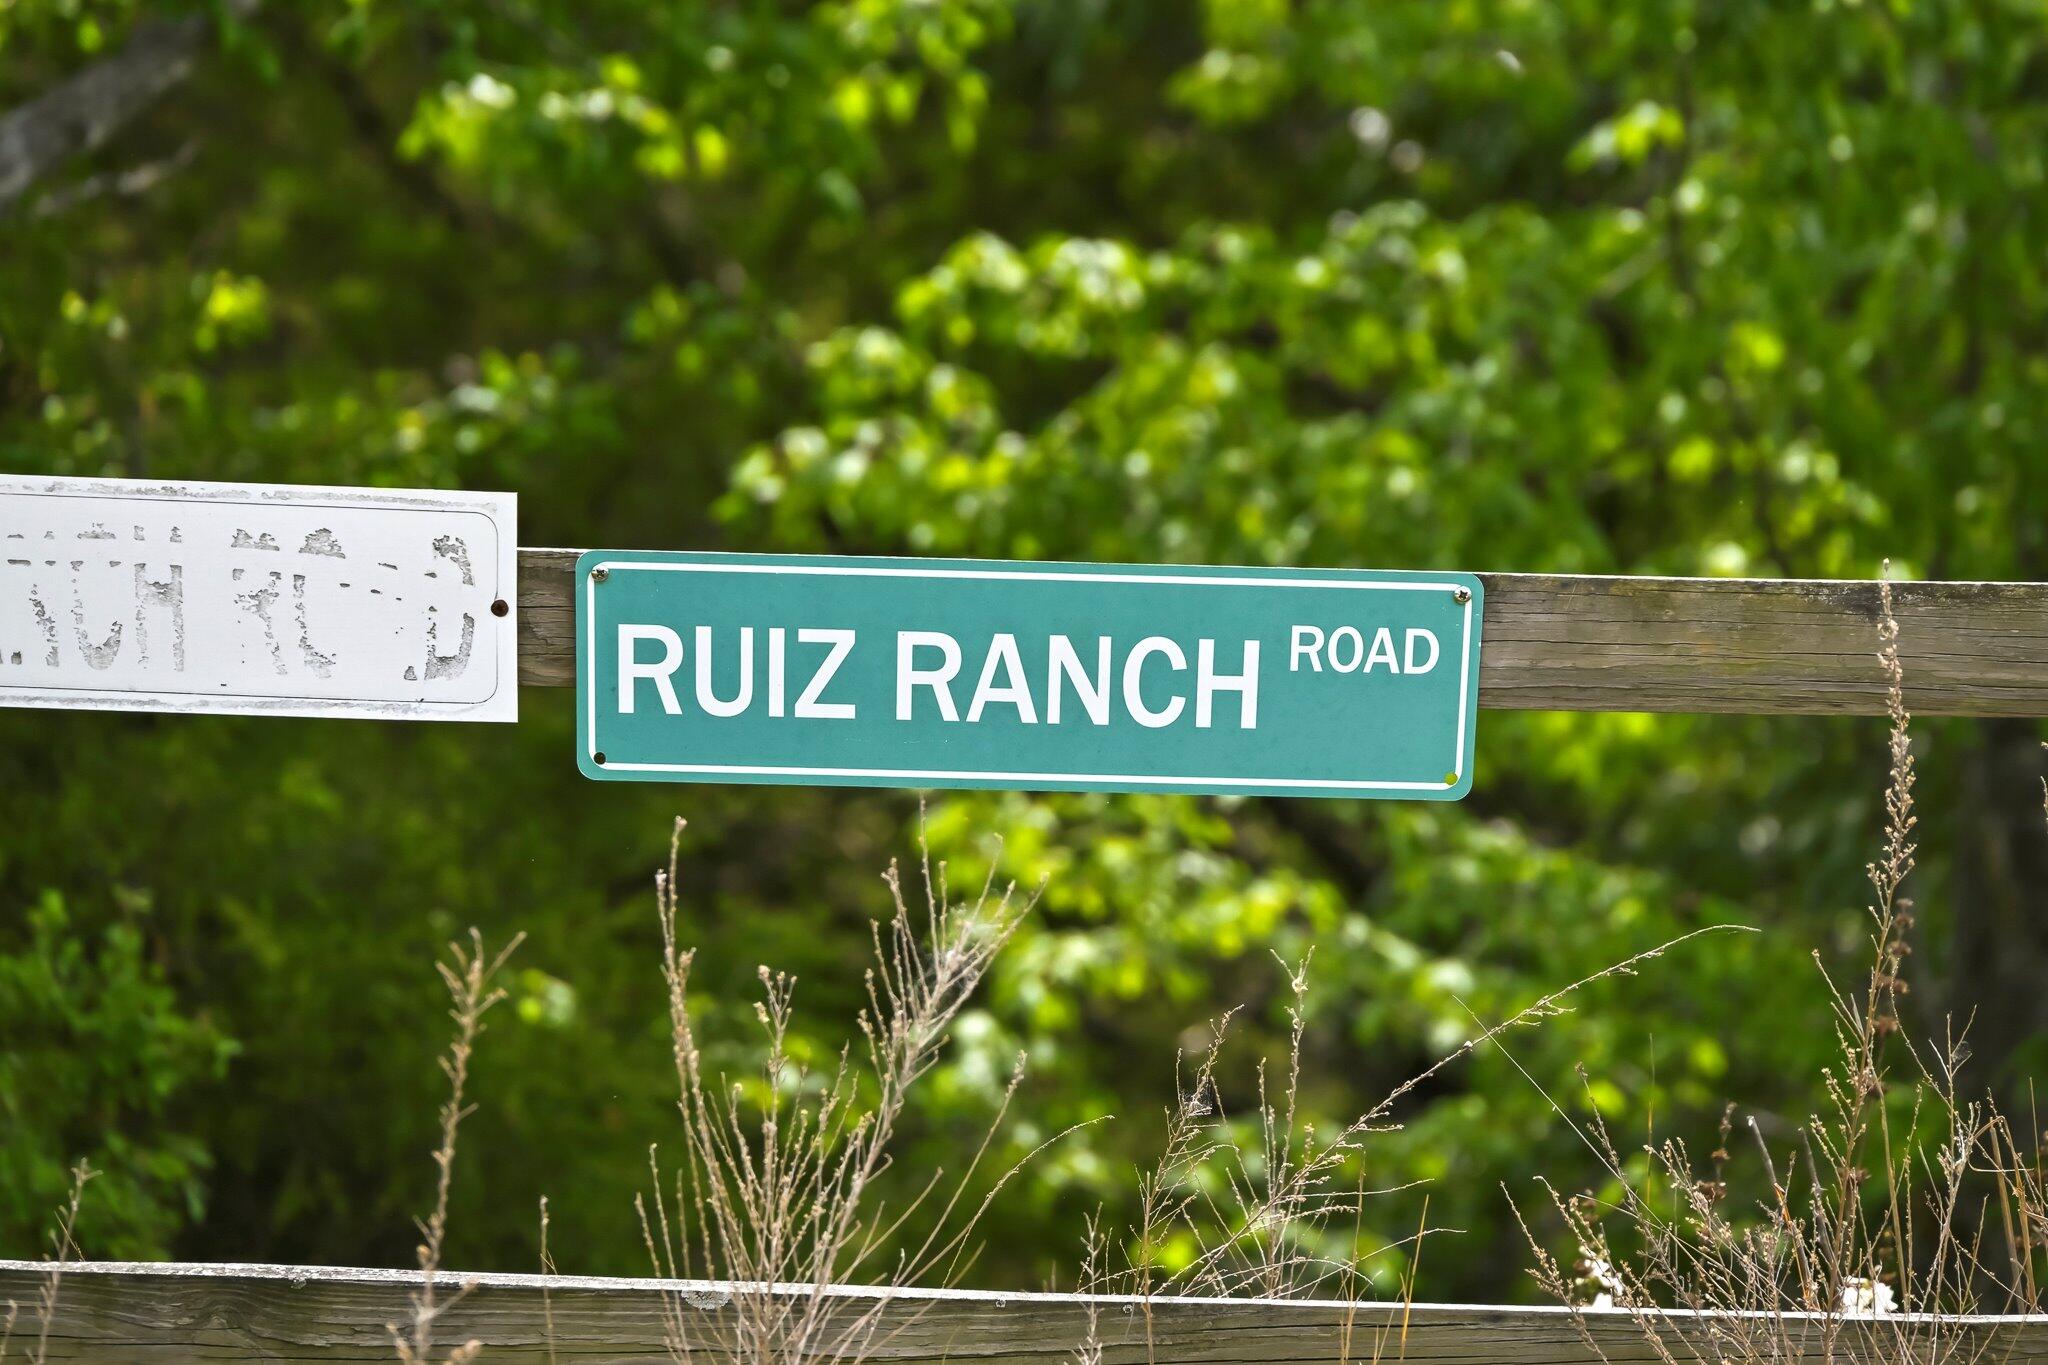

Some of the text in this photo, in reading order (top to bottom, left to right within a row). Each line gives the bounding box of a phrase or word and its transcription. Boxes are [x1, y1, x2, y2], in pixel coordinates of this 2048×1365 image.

[617, 623, 1440, 730] RUIZ RANCH ROAD
